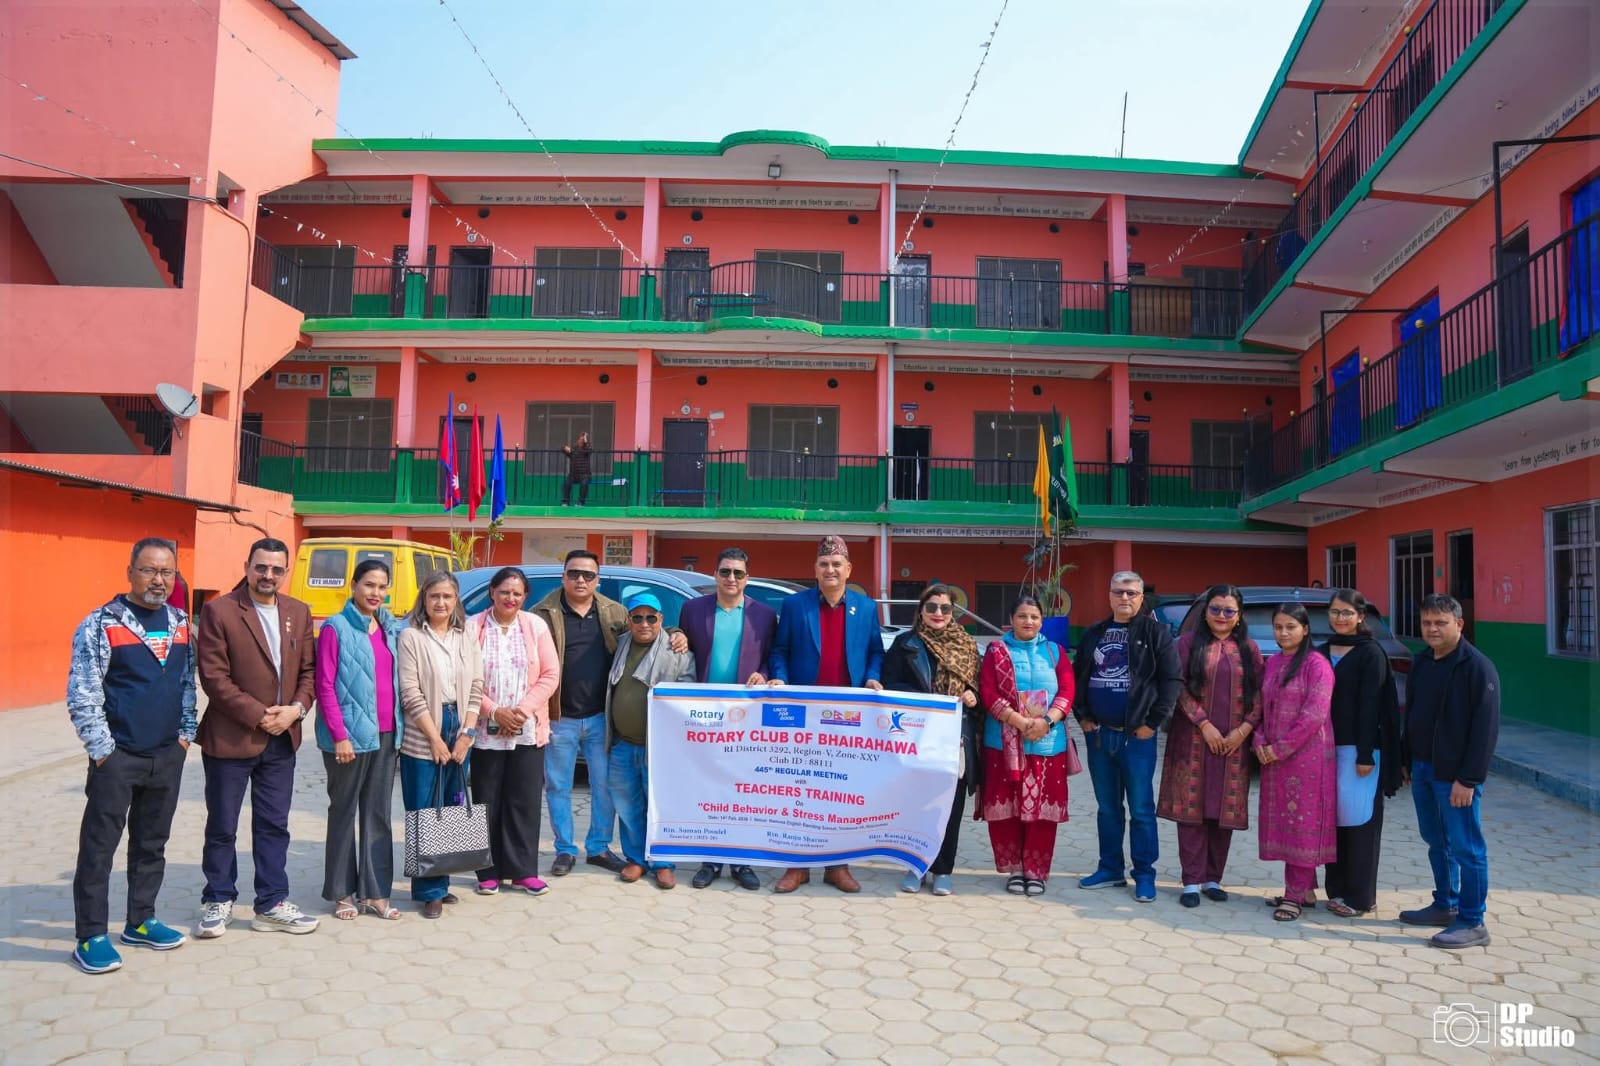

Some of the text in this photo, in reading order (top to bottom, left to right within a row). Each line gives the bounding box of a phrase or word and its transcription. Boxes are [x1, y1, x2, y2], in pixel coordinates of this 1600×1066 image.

[1544, 119, 1559, 137] being
[1561, 100, 1577, 121] blind
[1581, 437, 1590, 451] for
[690, 709, 725, 720] Rotary
[686, 730, 918, 756] ROTARY CLUB OF BHAIRAHAWA
[724, 745, 734, 753] RI
[735, 744, 767, 753] District
[769, 746, 792, 755] 3292,
[835, 750, 880, 762] Zone-XXV
[769, 756, 789, 765] Club
[791, 757, 803, 765] ID
[808, 759, 833, 768] 88111
[774, 767, 812, 777] REGULAR
[813, 770, 848, 781] MEETING
[735, 783, 865, 806] TEACHERS TRAINING
[698, 803, 729, 812] "Child
[732, 804, 778, 816] Behavior
[781, 807, 789, 817] &
[792, 808, 825, 822] Stress
